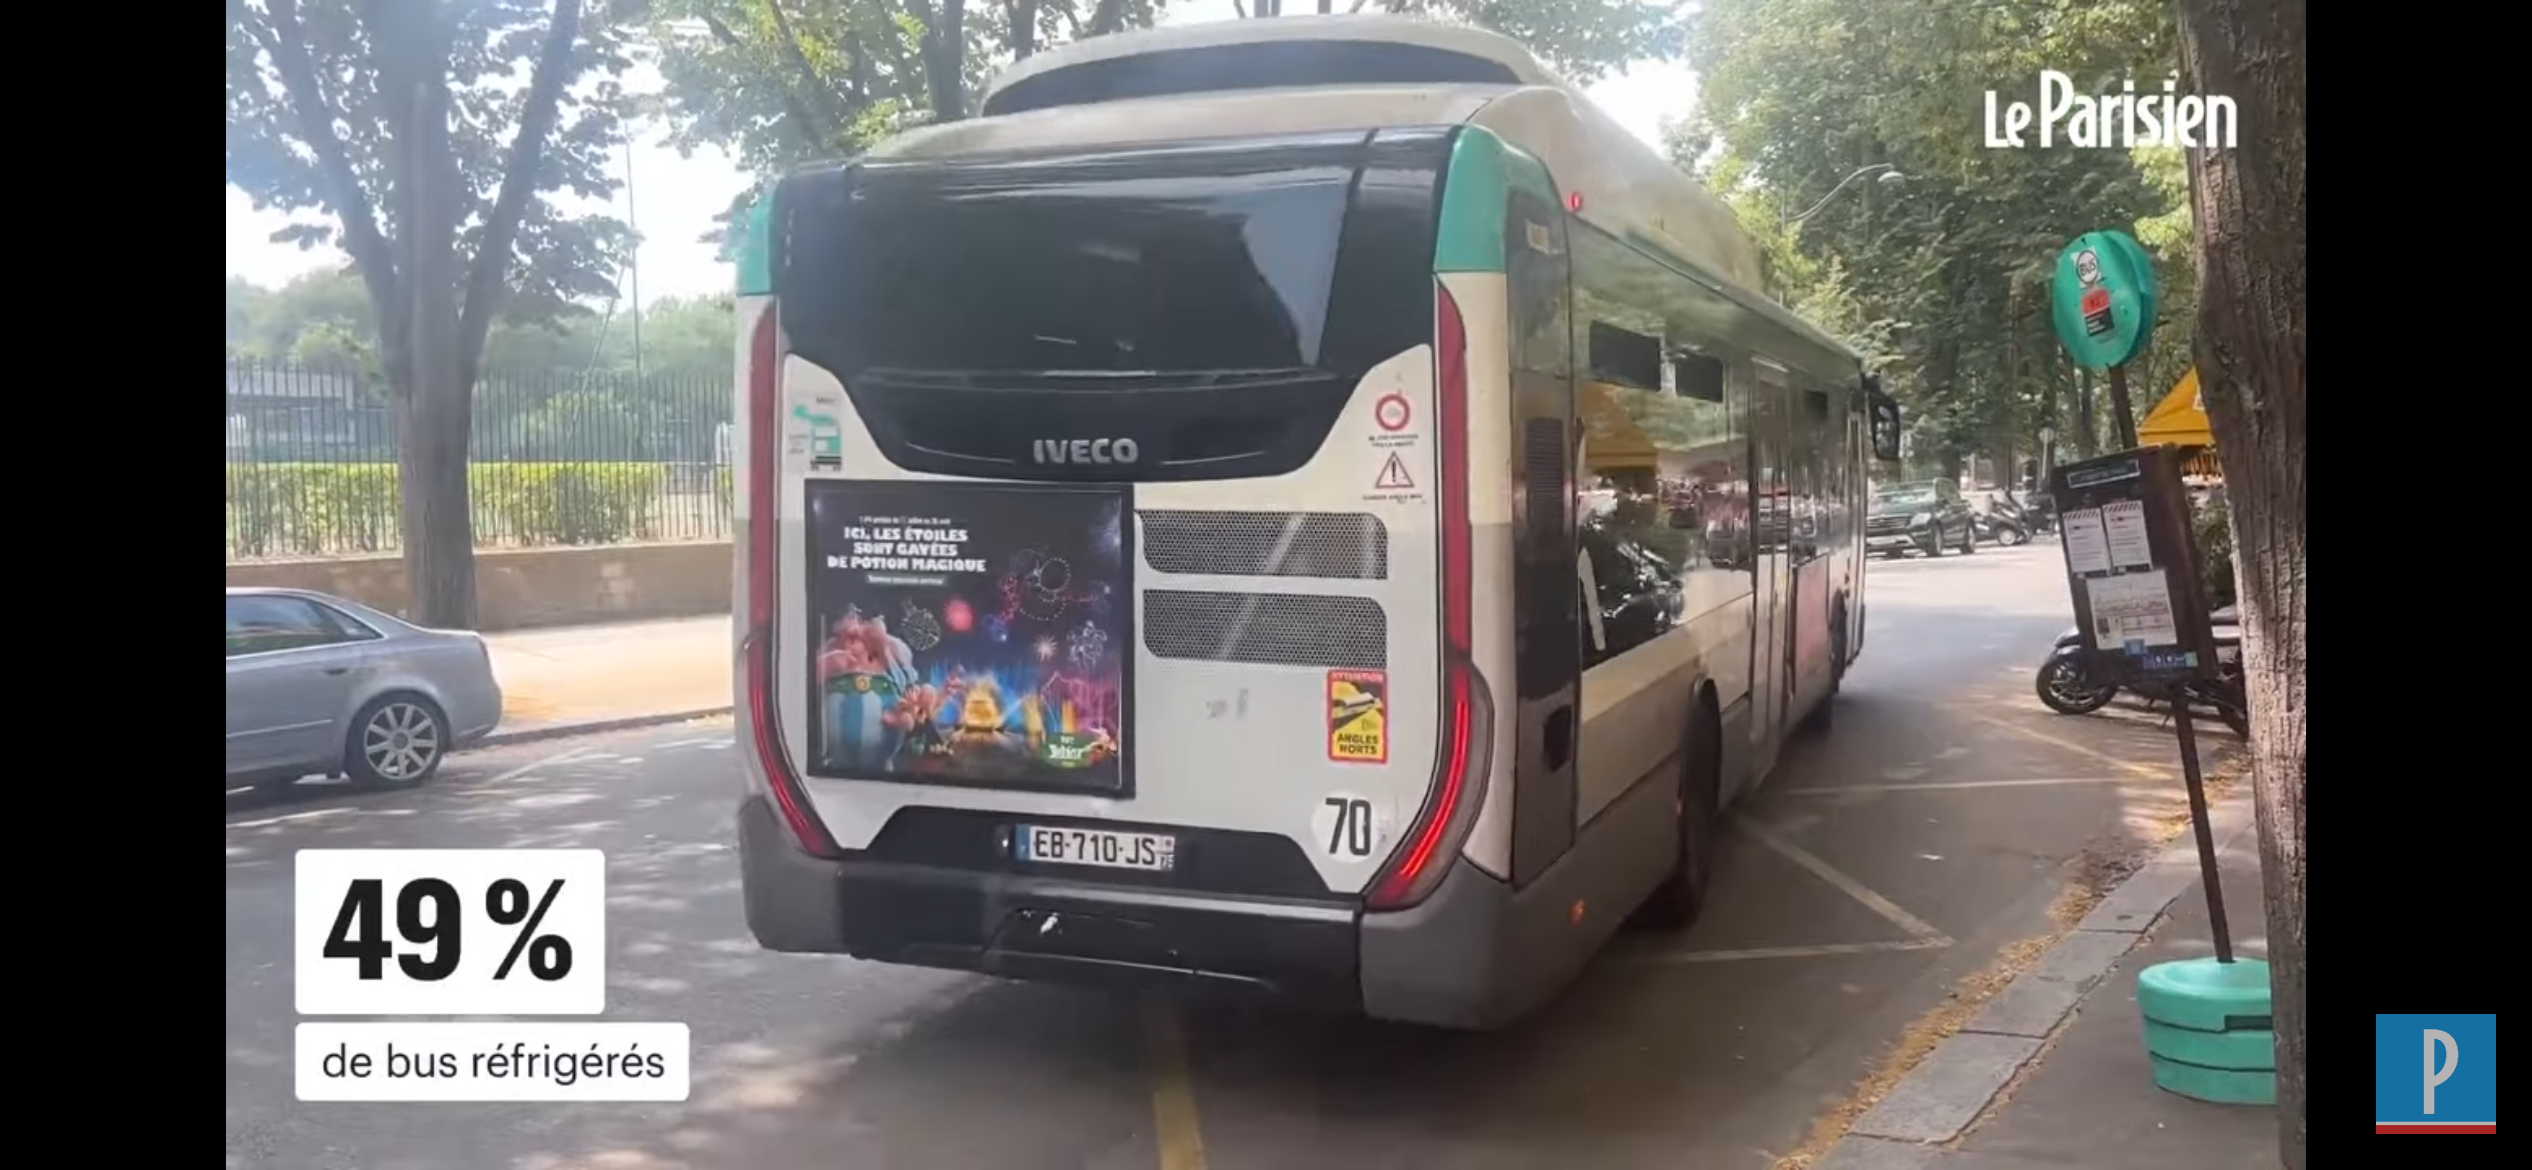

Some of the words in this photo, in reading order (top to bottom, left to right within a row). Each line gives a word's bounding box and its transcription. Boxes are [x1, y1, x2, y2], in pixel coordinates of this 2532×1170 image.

[1033, 438, 1139, 464] IVECO
[873, 527, 901, 541] LES
[904, 526, 968, 542] ÉTOILES
[853, 542, 893, 555] SONT
[827, 555, 848, 568] DE
[851, 556, 909, 570] POTION
[912, 558, 986, 573] MAGIQUE
[1337, 733, 1378, 745] ANGLES
[1339, 744, 1378, 755] MORTS
[1325, 797, 1371, 856] 70
